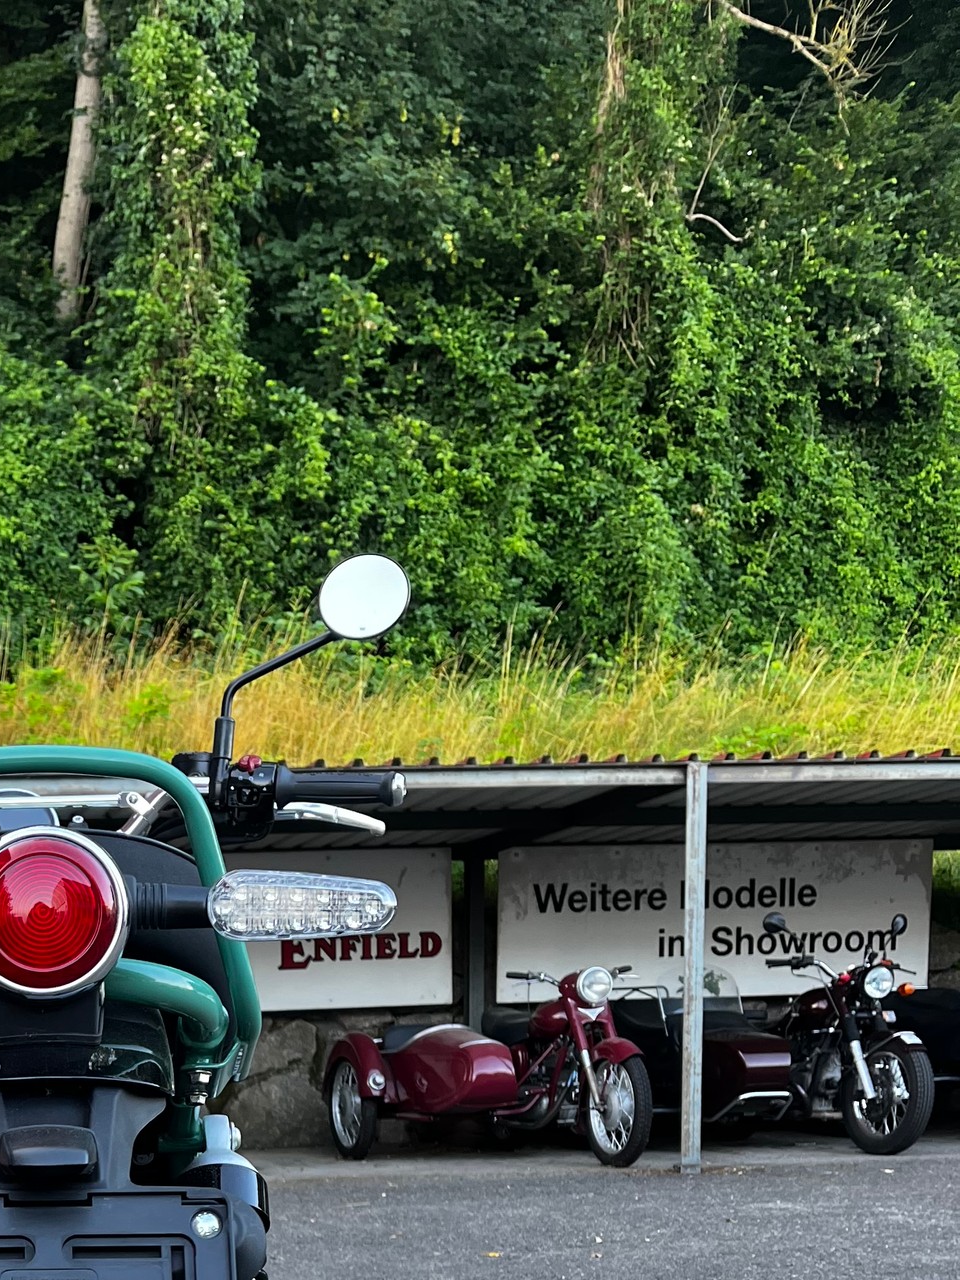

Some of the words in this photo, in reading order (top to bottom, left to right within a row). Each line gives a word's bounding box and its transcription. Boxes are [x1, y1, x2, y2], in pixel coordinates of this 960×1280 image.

[533, 882, 667, 913] Weitere
[680, 878, 817, 909] odelle
[278, 931, 443, 970] ENFIELD
[711, 925, 898, 957] Showroom
